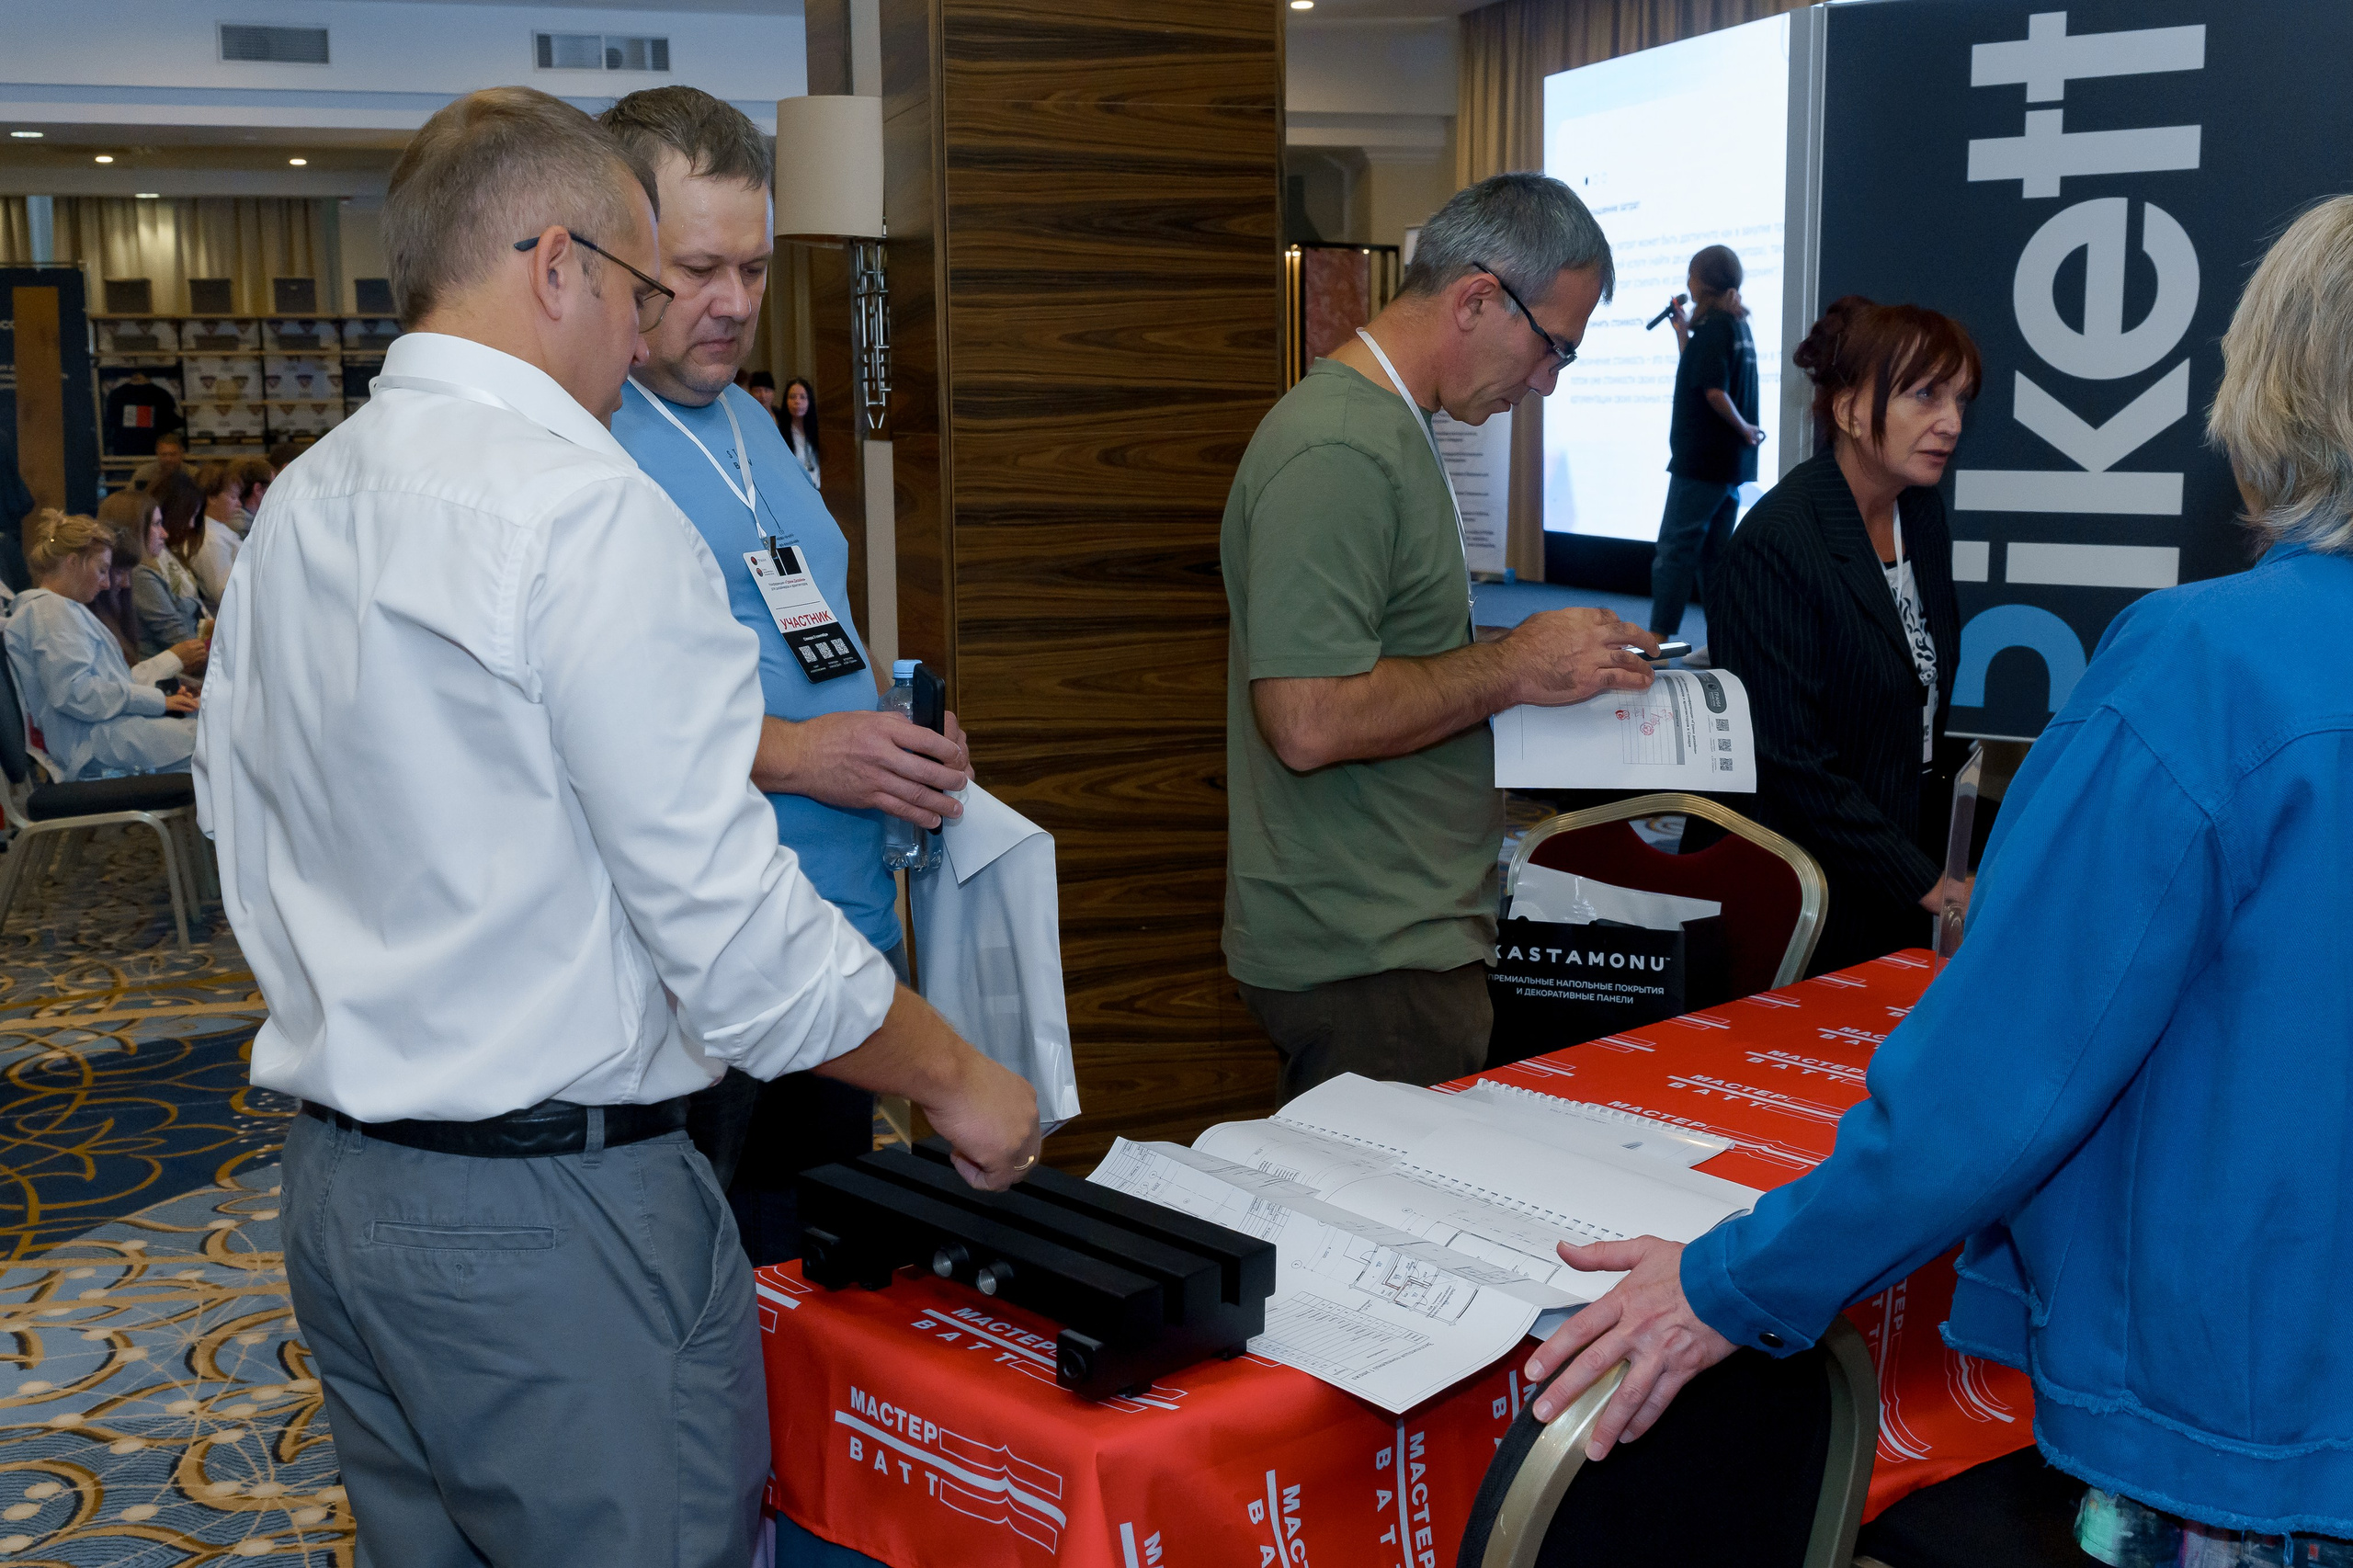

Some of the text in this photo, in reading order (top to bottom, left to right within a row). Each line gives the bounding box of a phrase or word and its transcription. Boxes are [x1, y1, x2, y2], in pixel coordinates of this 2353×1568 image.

[779, 610, 833, 631] УЧАСТНИК
[1488, 973, 1665, 994] ПРЕМИАЛЬНЫЕ НАПОЛЬНЫЕ ПОКРЫТИЯ
[1524, 988, 1595, 1001] ДЕКОРАТИВНЫЕ
[1597, 994, 1633, 1004] ПАНЕЛИ
[1746, 1057, 1844, 1080] ВАТТ
[1767, 1050, 1864, 1074] МАСТЕР
[1667, 1082, 1768, 1108] ВАТТ
[1689, 1074, 1788, 1101] МАСТЕР
[1607, 1100, 1708, 1130] МАСТЕР
[911, 1319, 1019, 1362] ВАТТ
[951, 1307, 1057, 1350] МАСТЕР
[850, 1385, 938, 1444] МАСТЕР
[849, 1436, 938, 1496] ВАТТ
[1376, 1446, 1400, 1568] ВАТ
[1409, 1431, 1436, 1568] МАСТЕР
[1282, 1483, 1308, 1568] МАС
